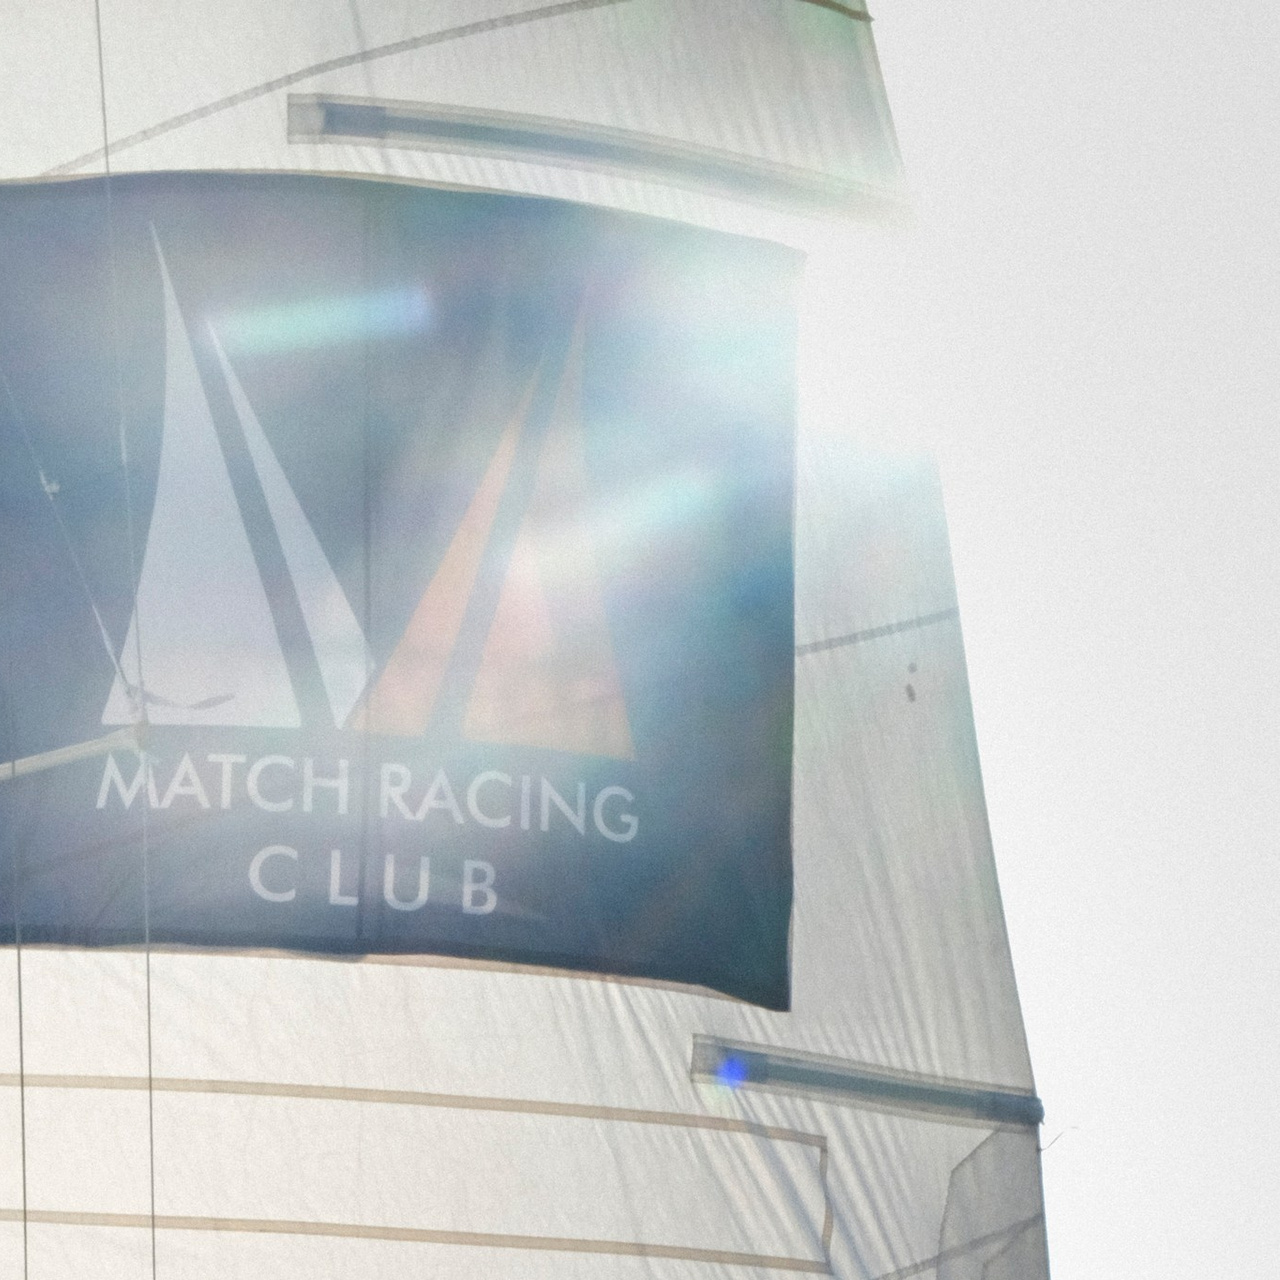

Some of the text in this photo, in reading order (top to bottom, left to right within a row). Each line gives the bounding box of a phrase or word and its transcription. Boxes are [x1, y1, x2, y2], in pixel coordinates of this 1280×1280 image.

[95, 752, 640, 842] MATCH RACING
[248, 844, 499, 914] CLUB
